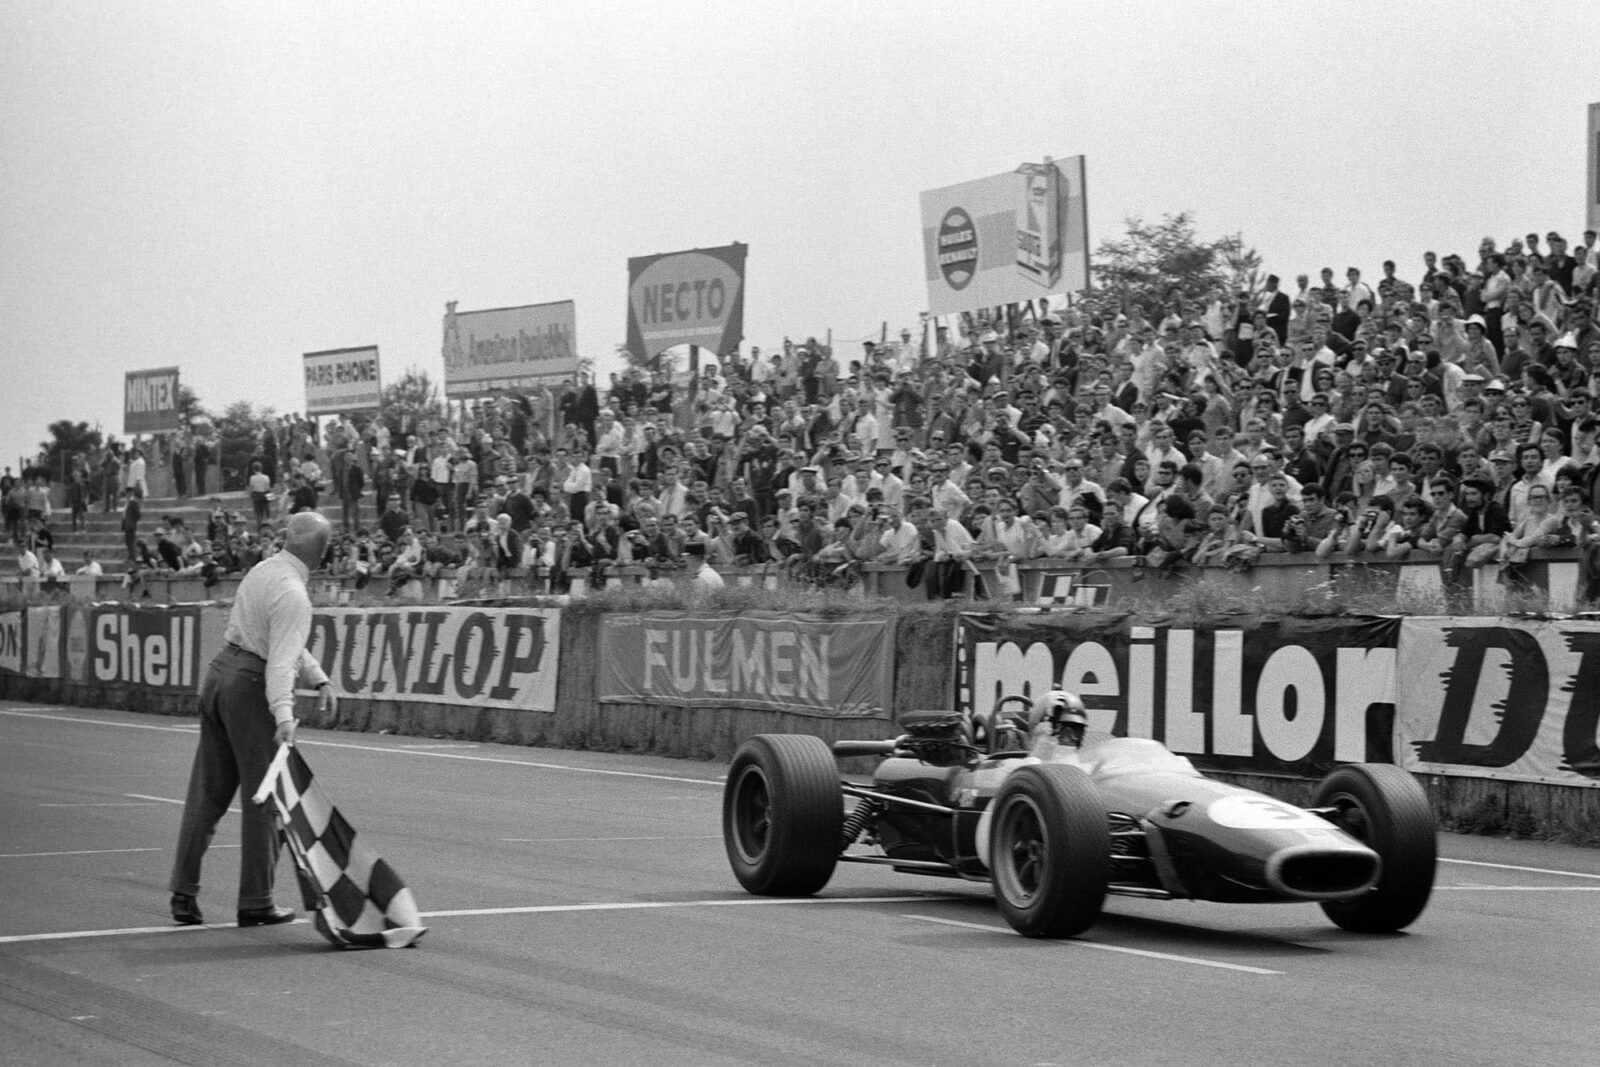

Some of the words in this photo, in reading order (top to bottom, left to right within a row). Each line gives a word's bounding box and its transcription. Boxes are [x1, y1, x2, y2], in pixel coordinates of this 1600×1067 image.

[643, 277, 726, 324] NECTO
[127, 375, 176, 412] MINTEX
[336, 359, 377, 384] RHONE
[94, 613, 194, 687] Shell
[297, 610, 548, 701] DUNLOP
[643, 628, 830, 700] FULMEN
